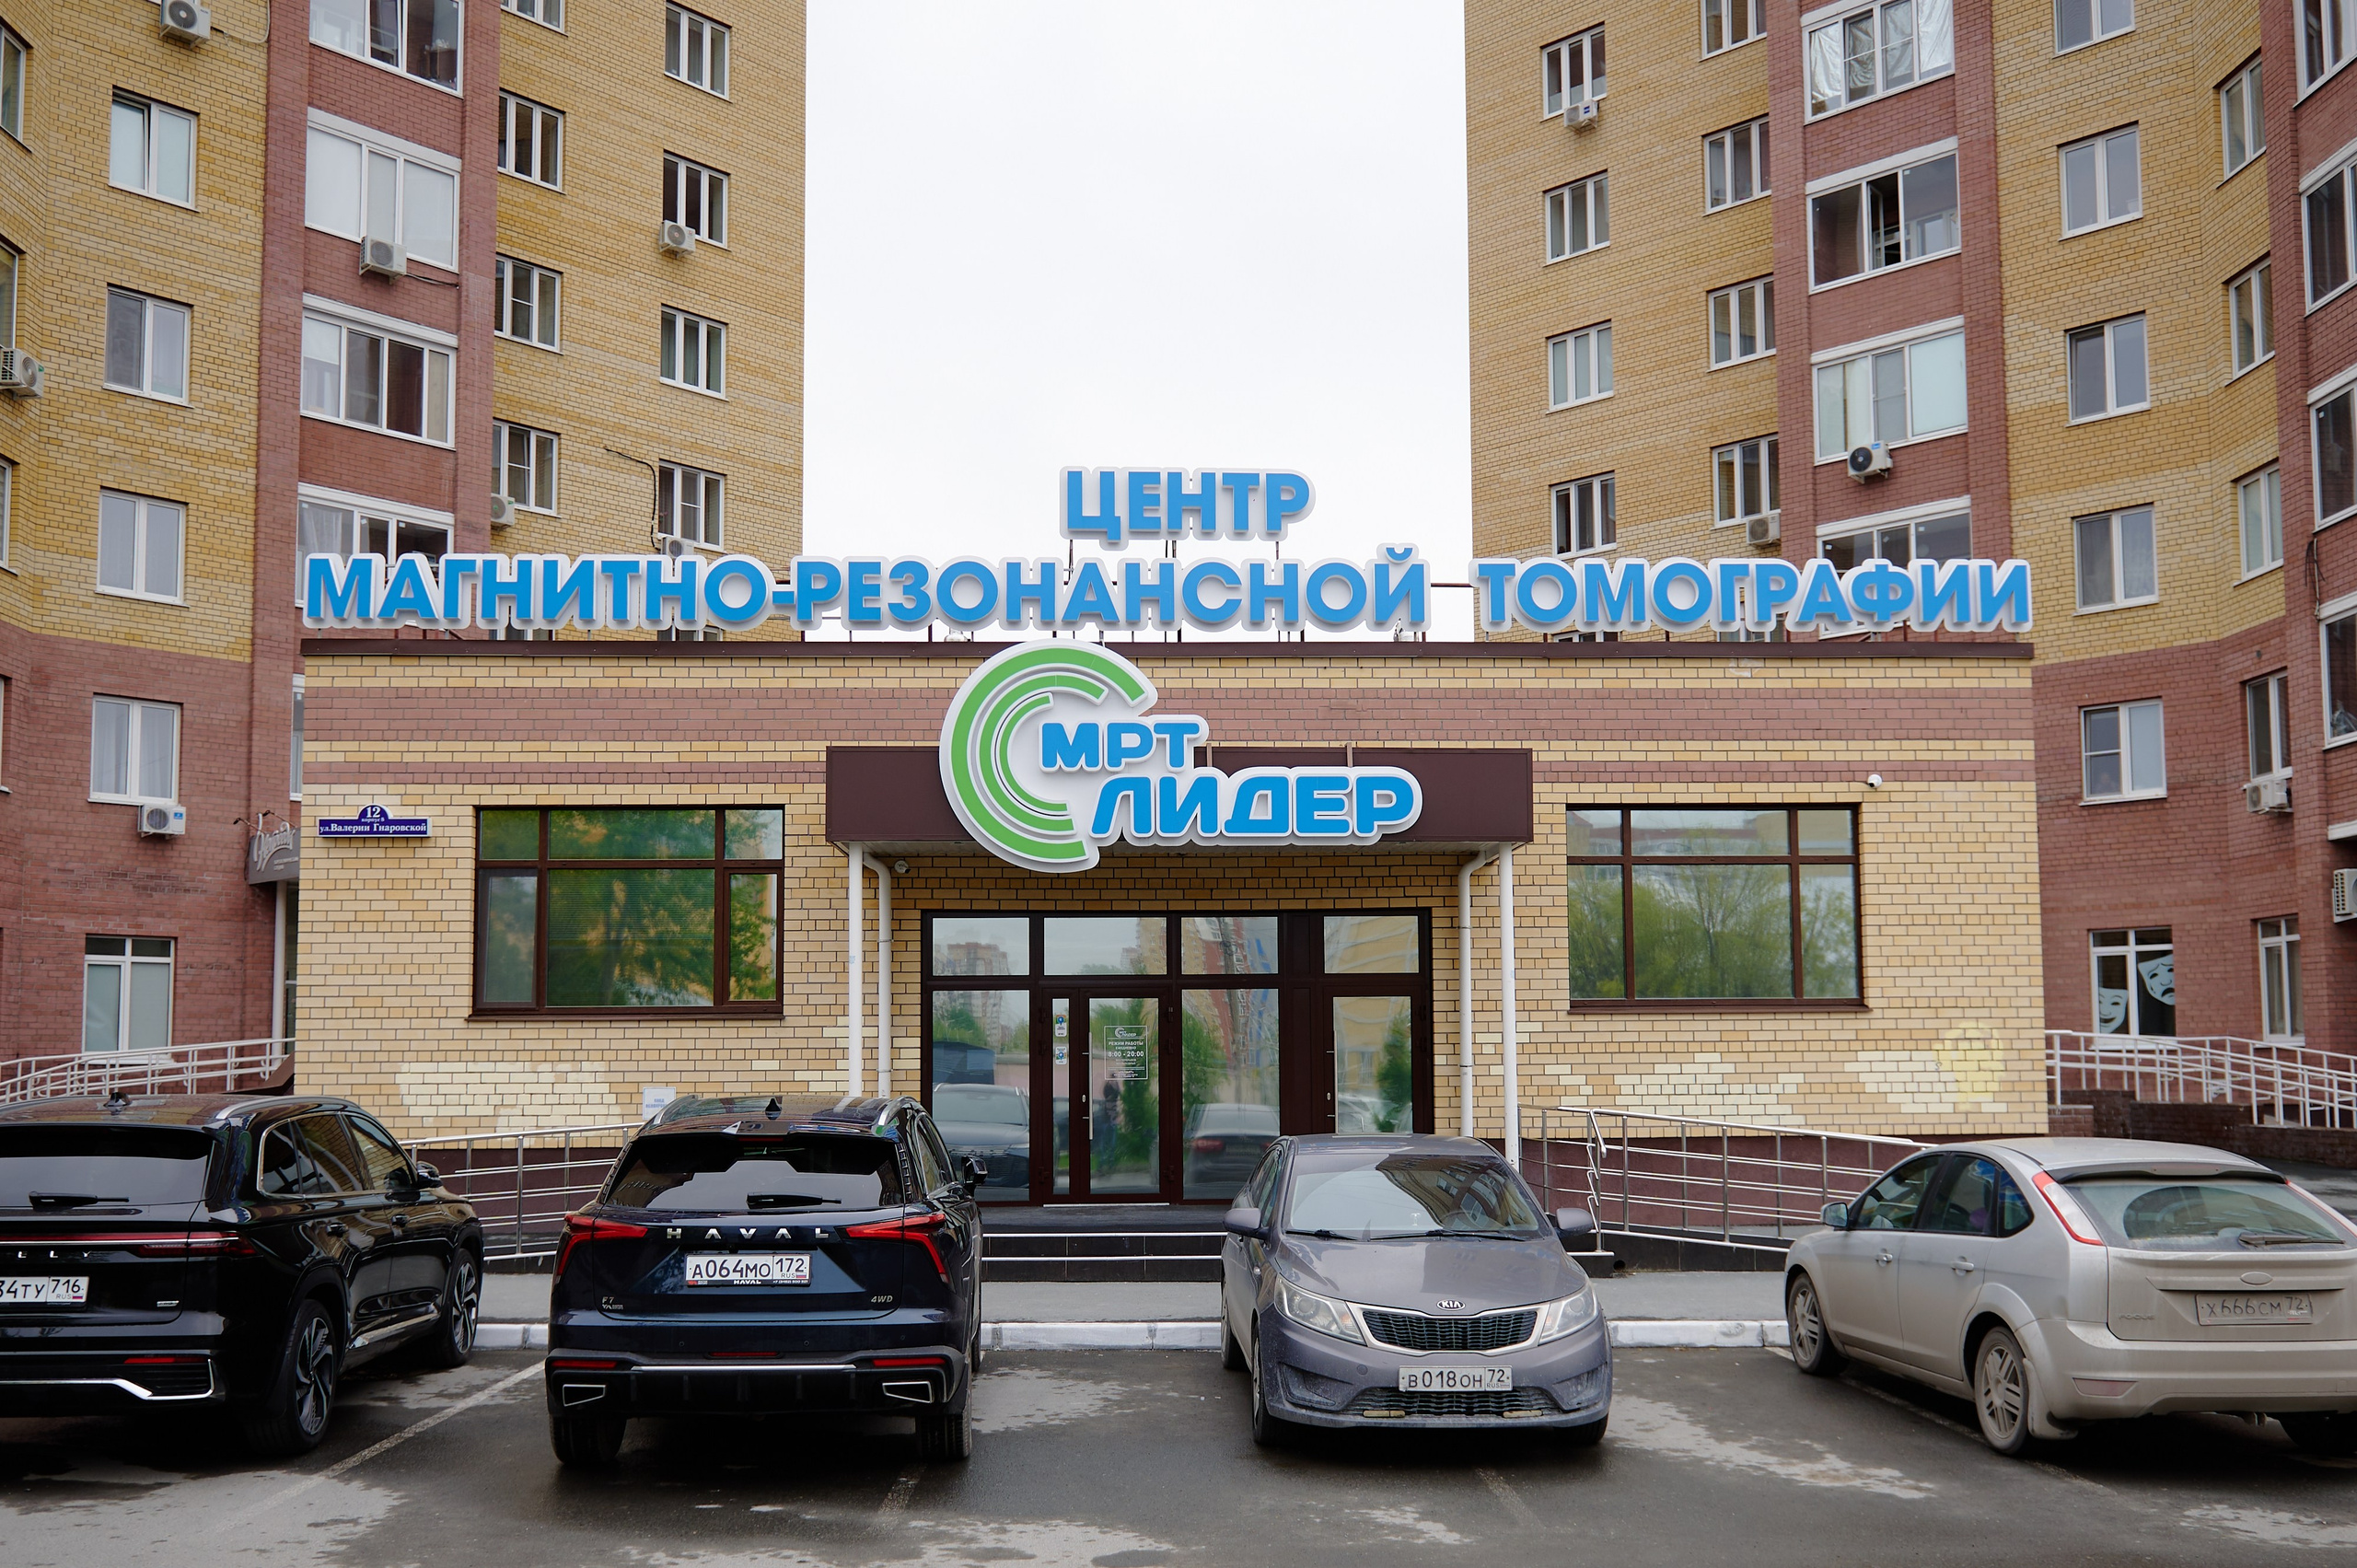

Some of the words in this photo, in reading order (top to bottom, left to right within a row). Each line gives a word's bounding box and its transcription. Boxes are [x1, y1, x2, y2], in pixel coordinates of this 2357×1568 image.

[1066, 470, 1309, 541] ЦЕНТР
[308, 548, 1426, 623] МАГНИТНО-РЕЗОНАНСНОЙ
[1478, 563, 2030, 623] ТОМОГРАФИИ
[1041, 722, 1201, 769] МРТ
[366, 807, 381, 818] 12
[1092, 775, 1415, 835] ЛИДЕР
[373, 822, 426, 833] Гнаровской
[667, 1227, 830, 1239] HAVAL
[691, 1260, 771, 1279] А064МО
[775, 1258, 805, 1272] 172
[52, 1279, 81, 1294] 716
[870, 1295, 894, 1303] 4WD
[2206, 1298, 2282, 1317] Х666СМ
[2285, 1296, 2304, 1310] 72
[1408, 1370, 1482, 1388] В018ОН
[1487, 1369, 1505, 1383] 72
